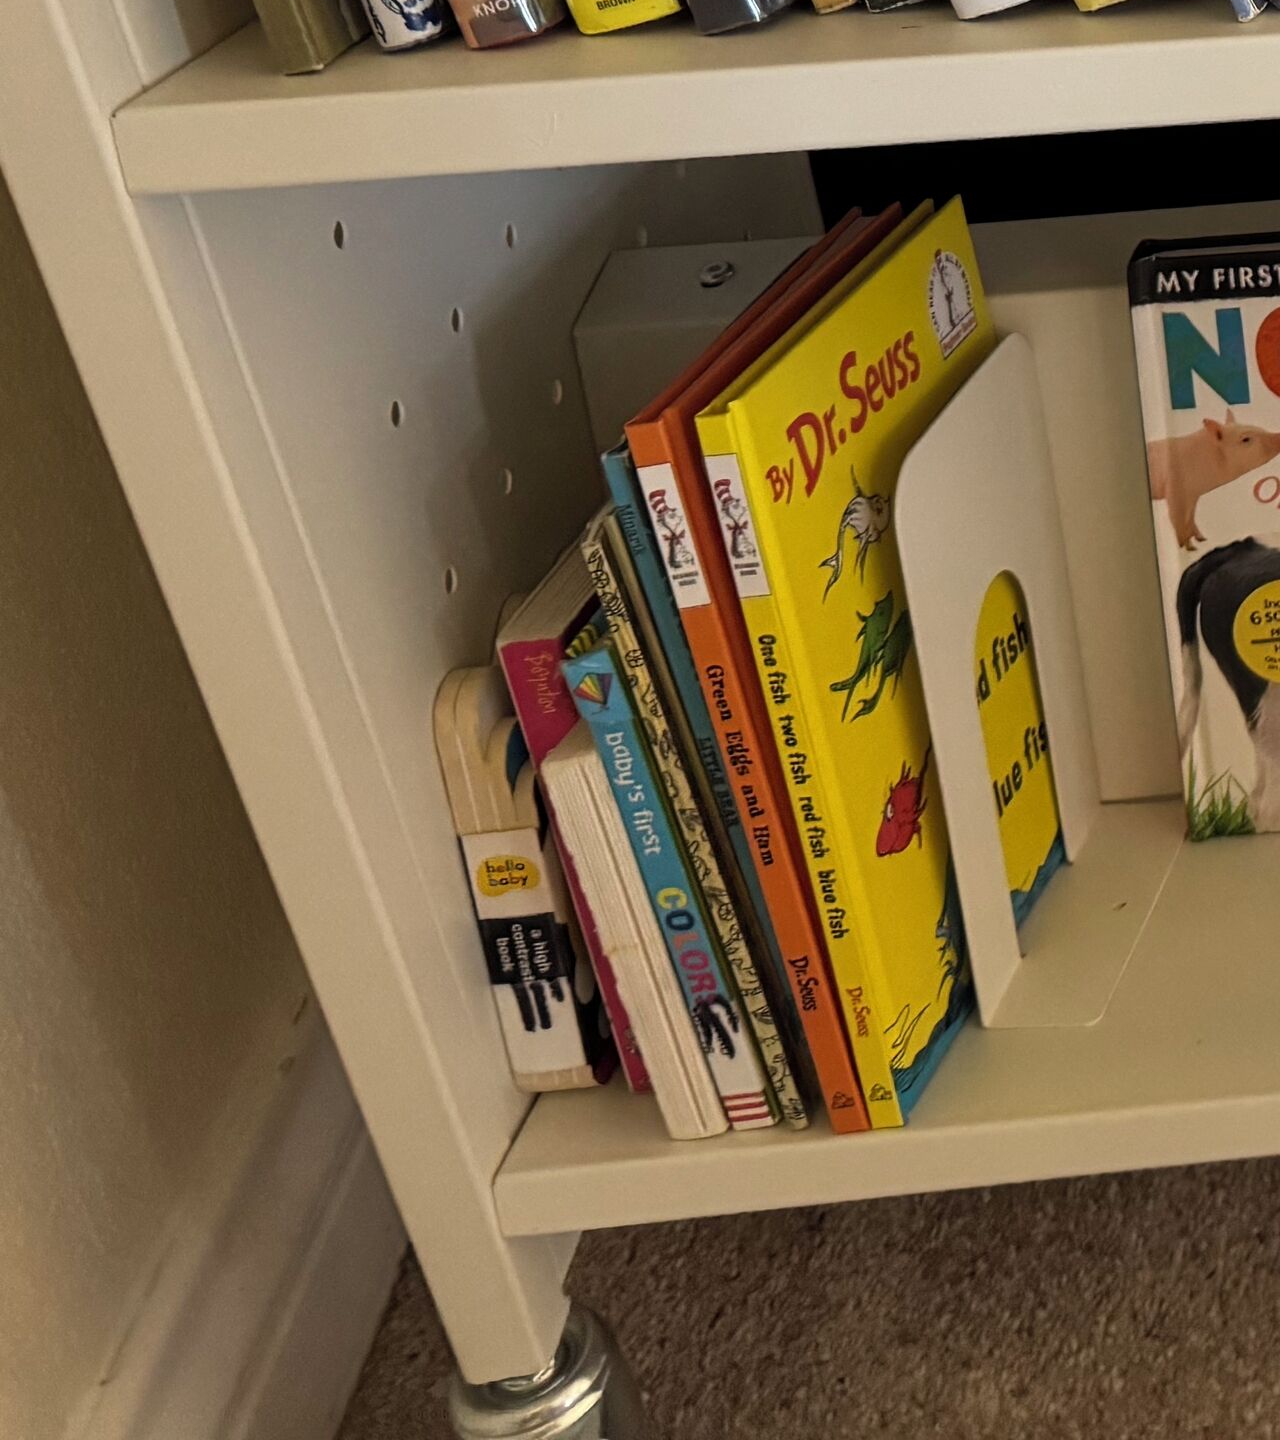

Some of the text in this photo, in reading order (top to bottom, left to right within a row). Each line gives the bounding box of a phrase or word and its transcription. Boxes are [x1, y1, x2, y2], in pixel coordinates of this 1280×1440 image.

[1156, 270, 1199, 294] MY
[764, 459, 796, 505] By
[785, 402, 849, 498] Dr.
[838, 329, 922, 435] Seuss
[1249, 610, 1263, 626] 6
[992, 612, 1029, 682] fish
[604, 731, 646, 803] baby's
[705, 663, 819, 1012] Green Eggs and Ham Dr. Seuss
[758, 633, 870, 1040] One fish two fish red fish blue fish Dr. Seuss
[484, 860, 526, 874] hello
[488, 872, 529, 889] baby
[495, 936, 516, 973] book
[511, 922, 536, 983] contrast
[532, 941, 553, 974] high
